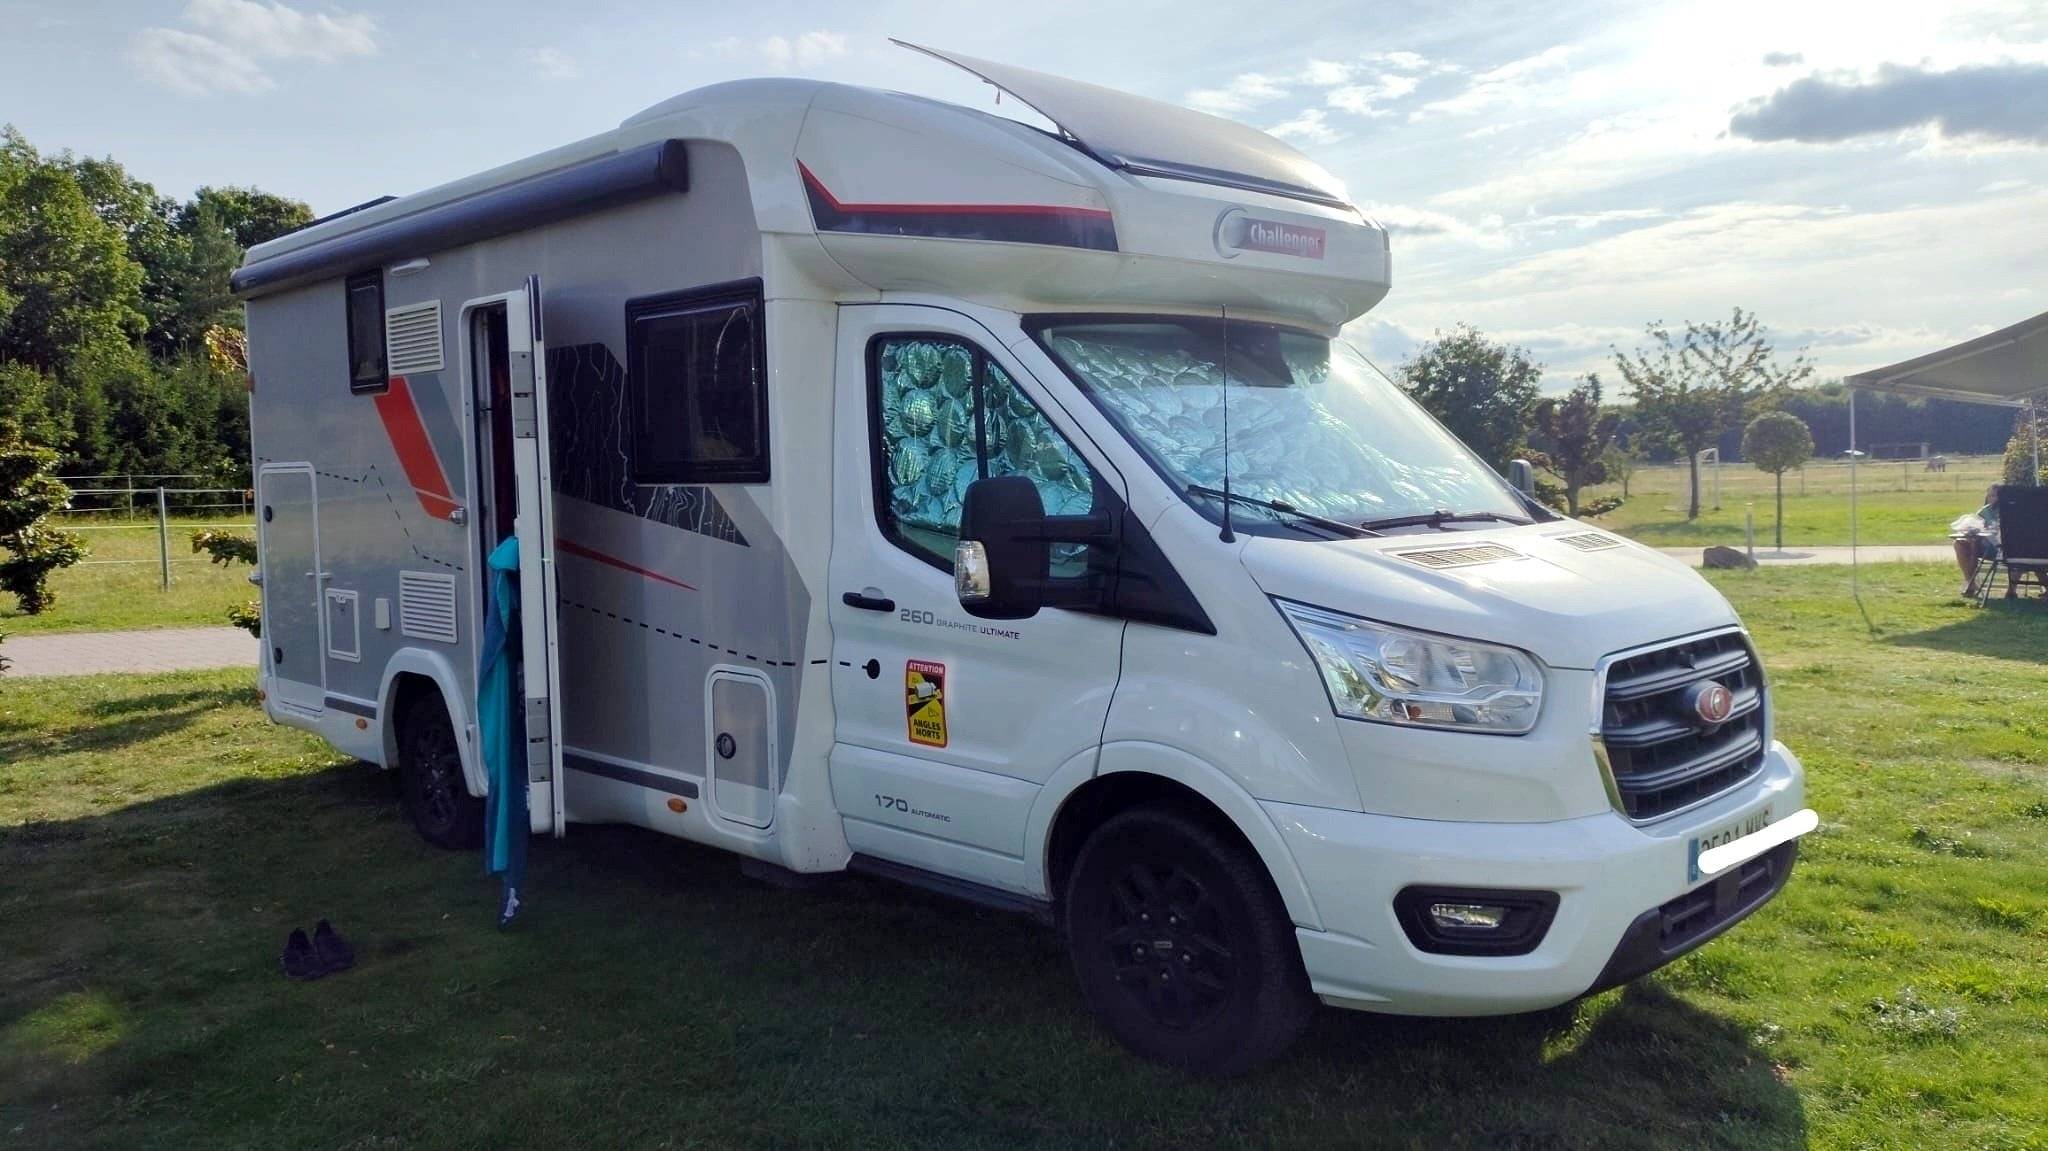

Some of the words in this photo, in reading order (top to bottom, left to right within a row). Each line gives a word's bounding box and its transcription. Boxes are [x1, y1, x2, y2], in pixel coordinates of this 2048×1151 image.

[1250, 223, 1322, 252] Challenger
[900, 608, 934, 625] 260
[936, 618, 977, 633] GRAPHITE
[980, 626, 1020, 640] ULTIMATE
[909, 661, 945, 675] ATTENTION
[913, 718, 941, 731] ANGLES
[915, 727, 941, 740] MORTS
[874, 794, 908, 813] 170
[911, 808, 952, 823] AUTOMATIC
